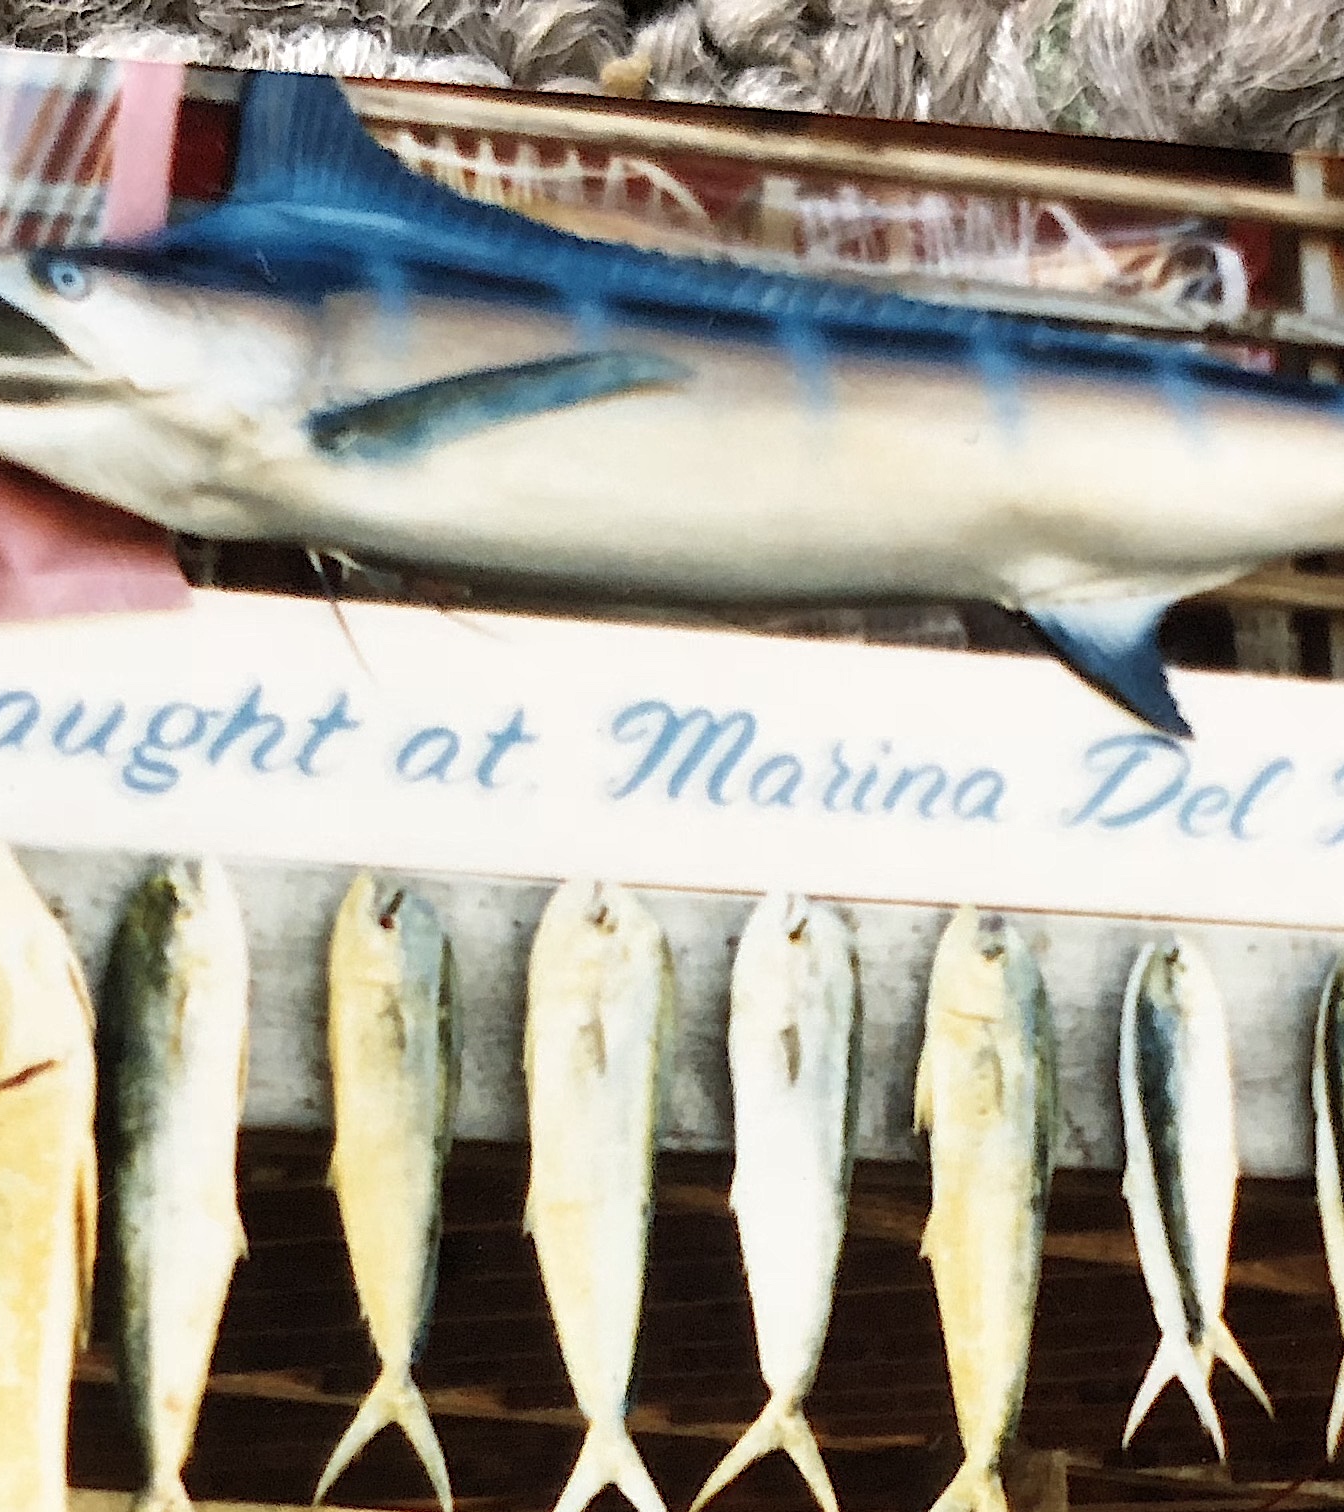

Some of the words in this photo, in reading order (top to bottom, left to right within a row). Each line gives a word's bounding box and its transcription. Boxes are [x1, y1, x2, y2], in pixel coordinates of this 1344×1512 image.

[394, 708, 535, 790] at
[606, 697, 1009, 821] Marina
[1064, 731, 1295, 843] Del
